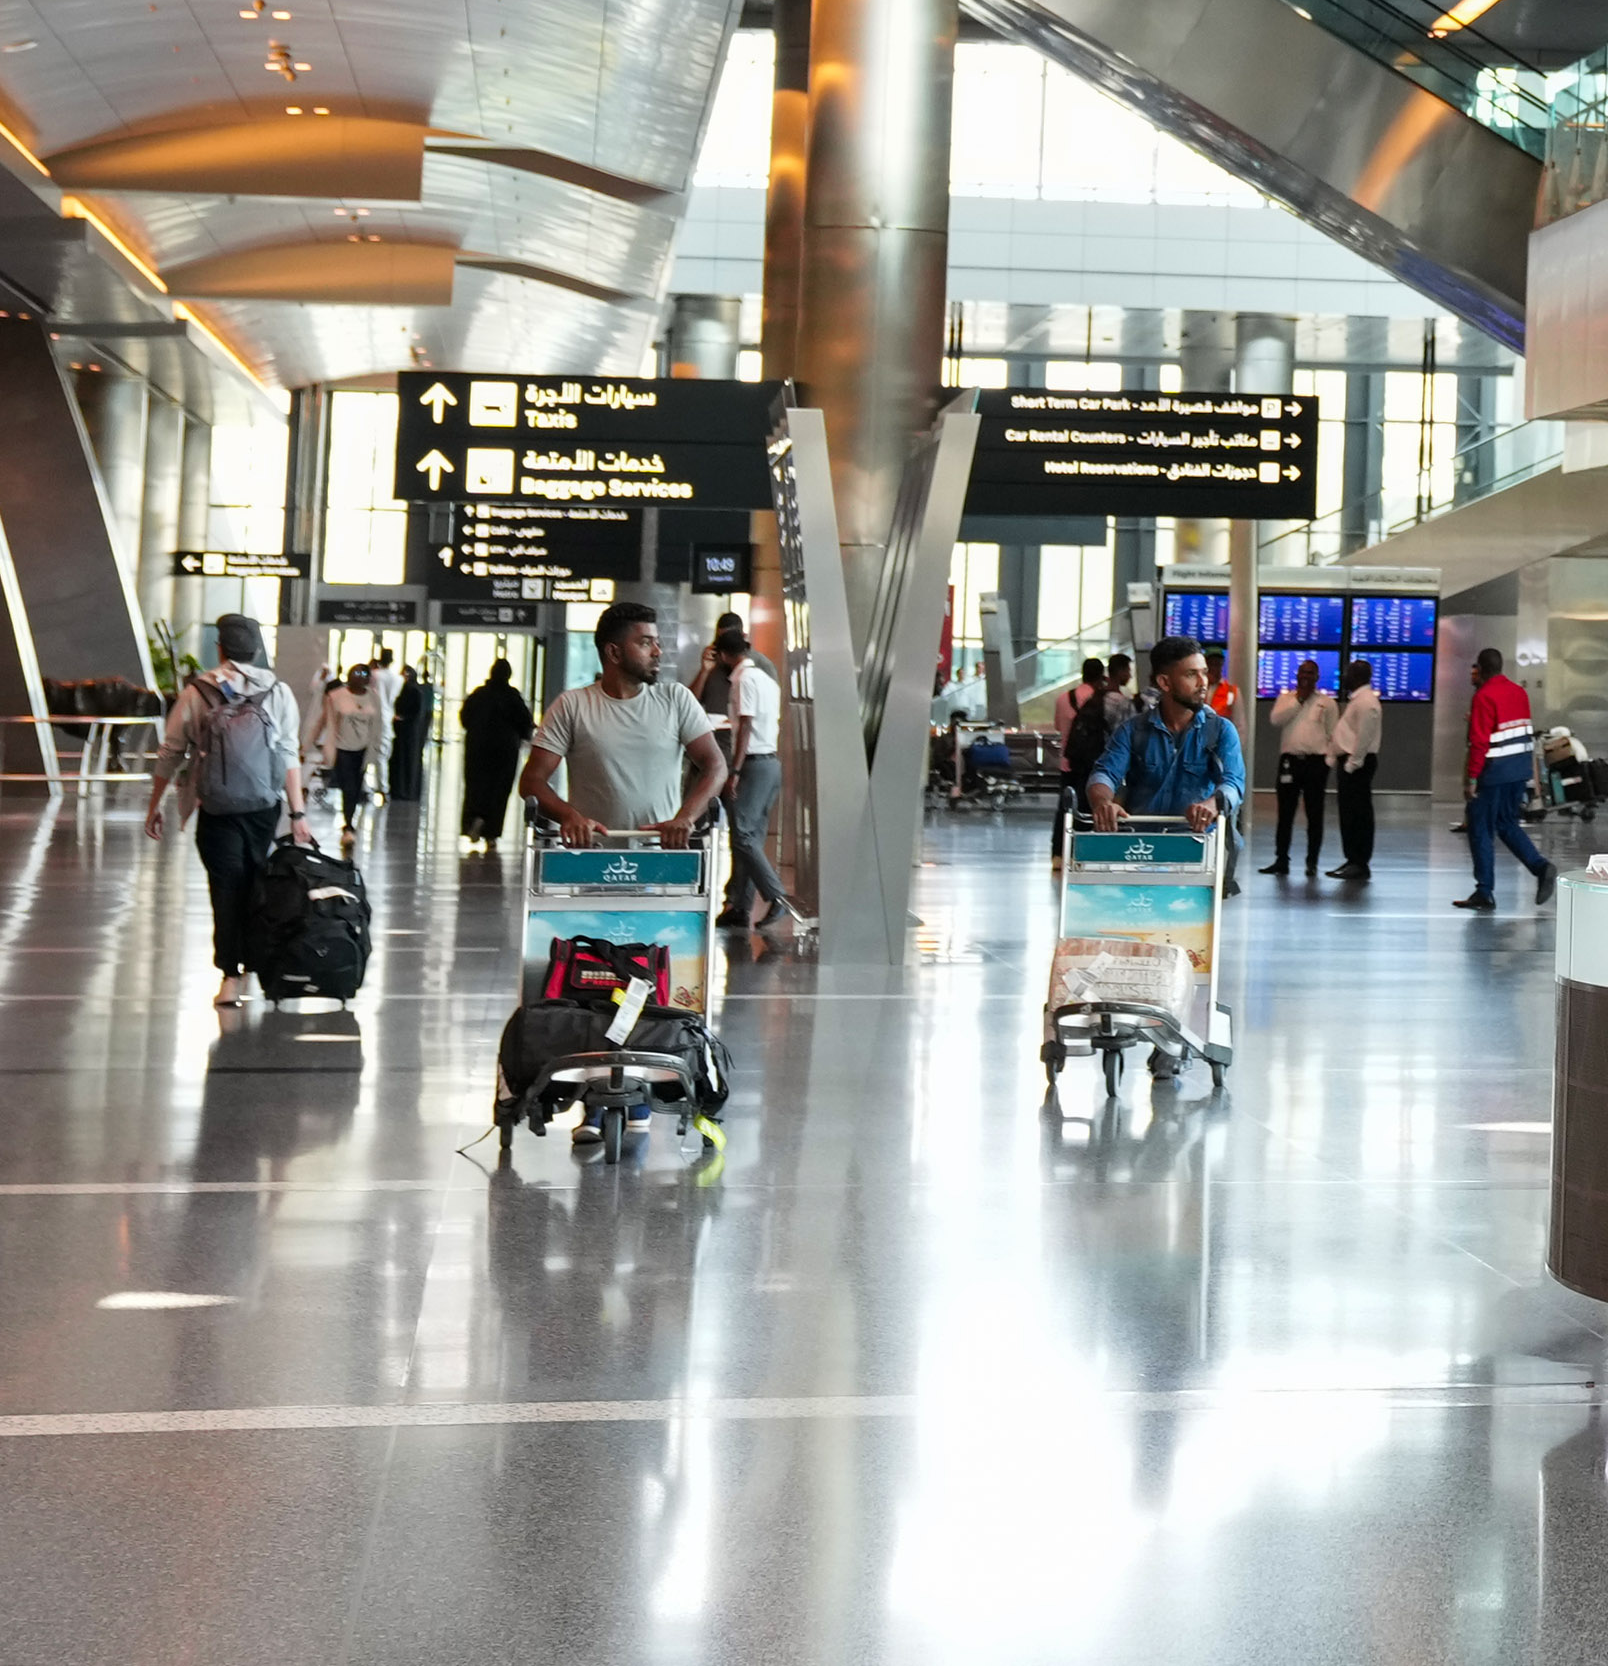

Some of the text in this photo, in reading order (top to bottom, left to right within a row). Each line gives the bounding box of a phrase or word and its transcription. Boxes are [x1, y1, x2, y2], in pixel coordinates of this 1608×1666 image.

[1010, 394, 1131, 411] Short Term Car Park
[524, 409, 578, 429] Taxis
[1005, 428, 1127, 444] Car Rental Counters
[1044, 460, 1159, 476] Hotel Reservations
[520, 476, 693, 501] Baggage Services
[602, 874, 638, 882] QATAR
